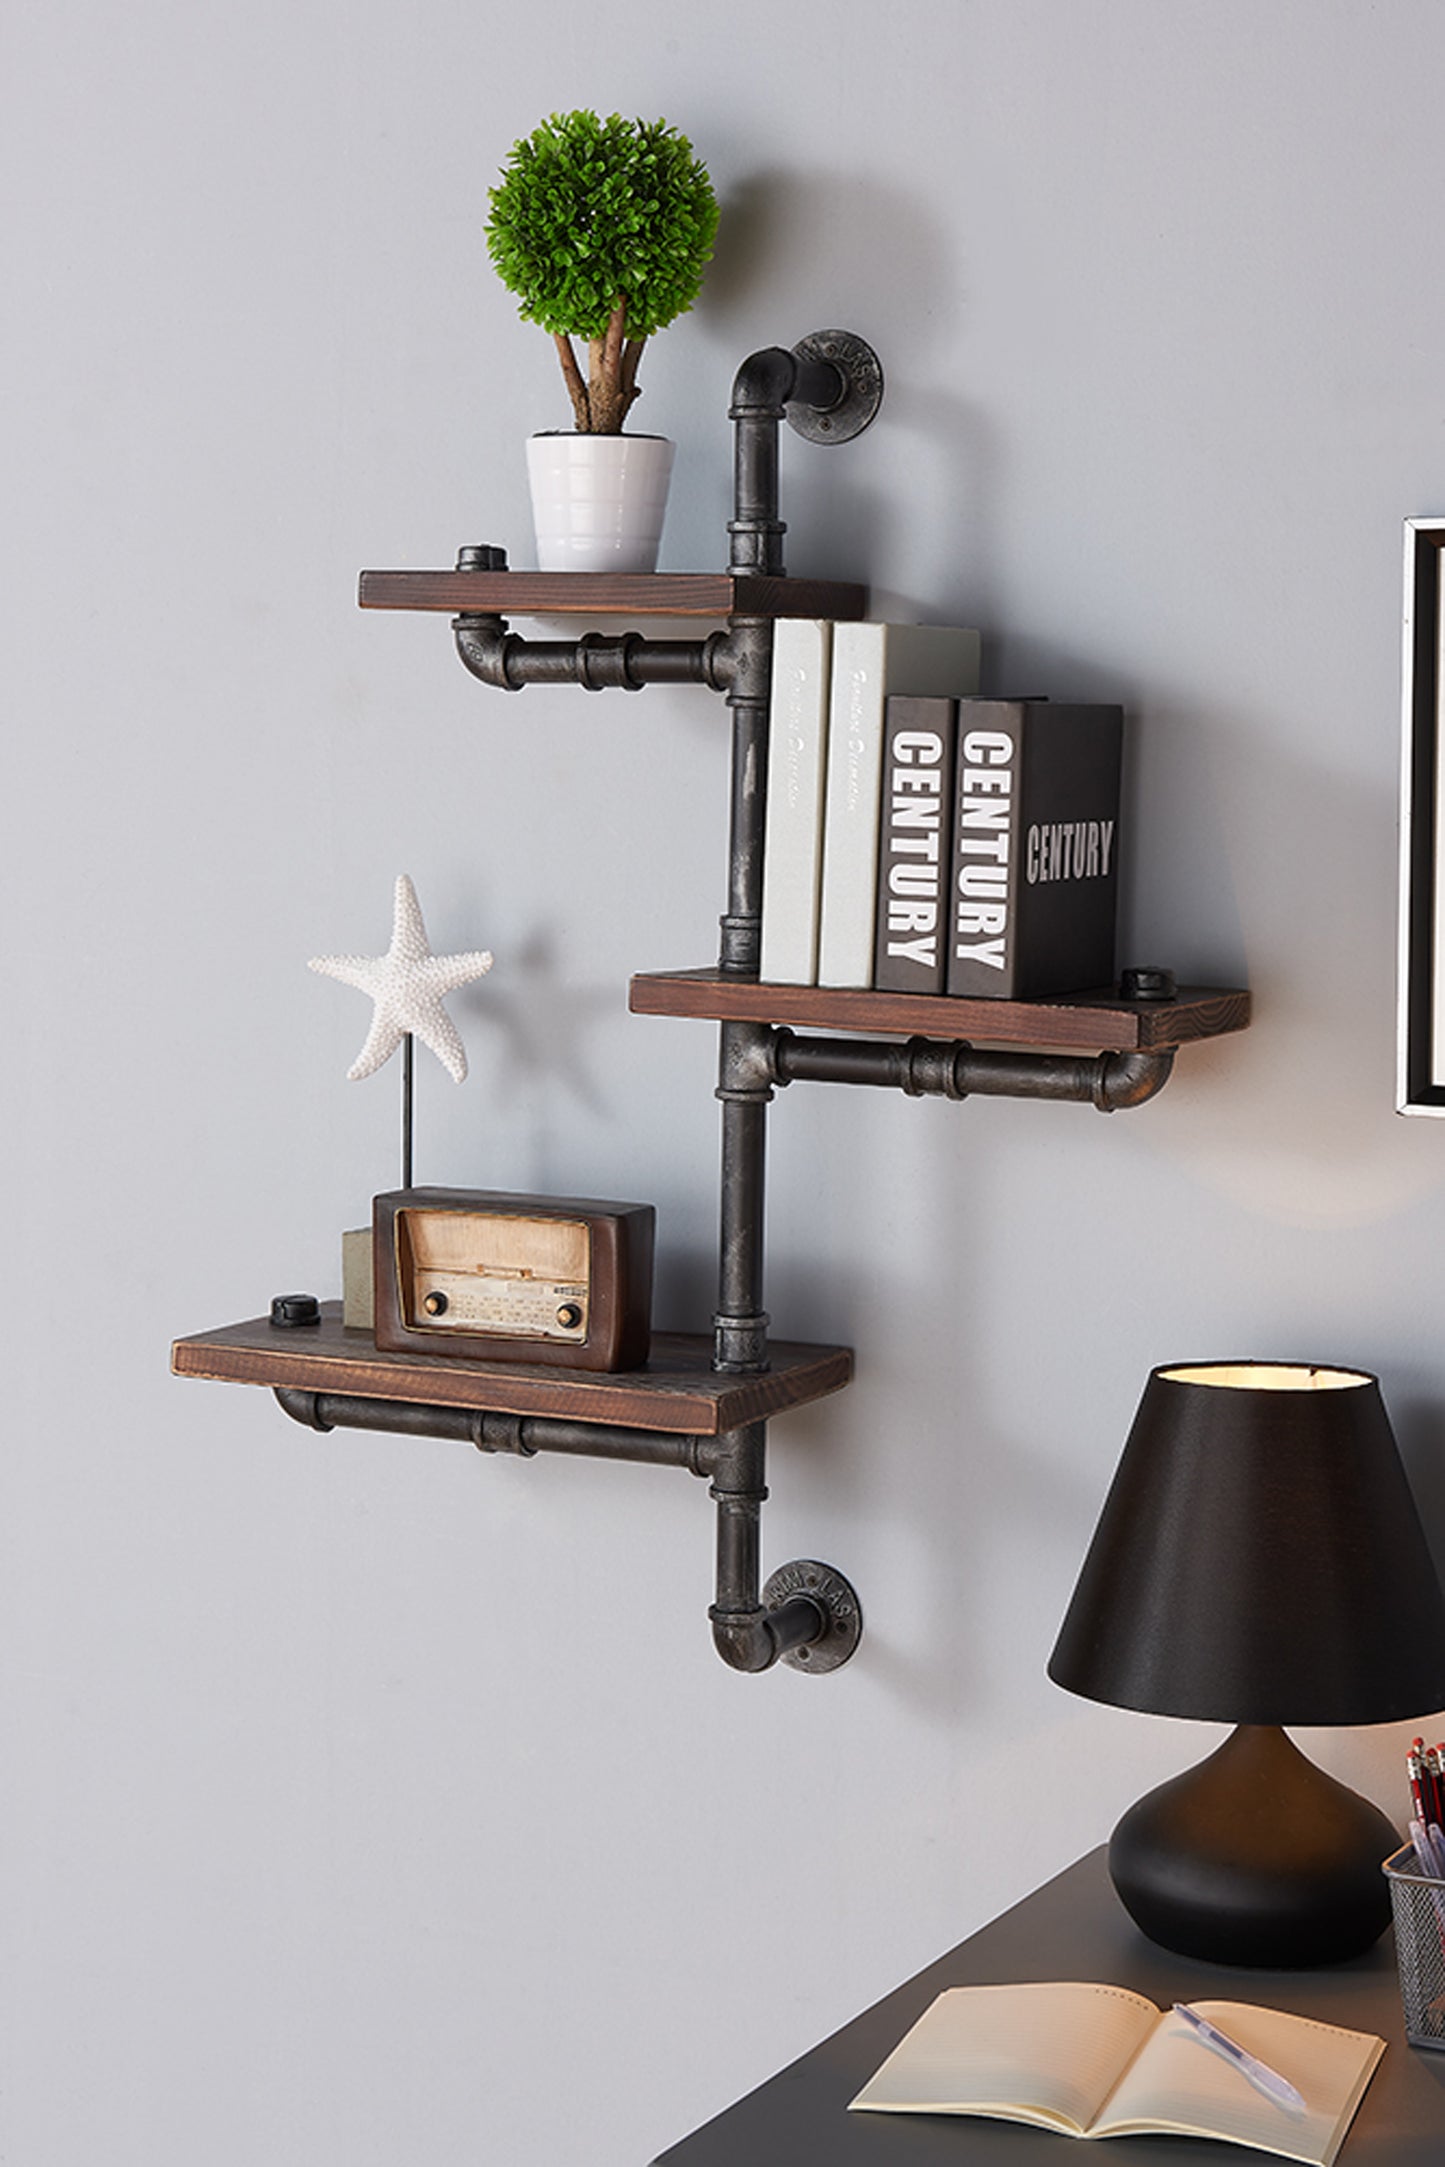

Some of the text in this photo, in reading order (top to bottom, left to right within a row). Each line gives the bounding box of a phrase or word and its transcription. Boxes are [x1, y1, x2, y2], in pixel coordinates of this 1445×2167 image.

[888, 731, 943, 968] CENTURY
[956, 731, 1013, 970] CENTURY
[1026, 821, 1114, 885] CENTURY
